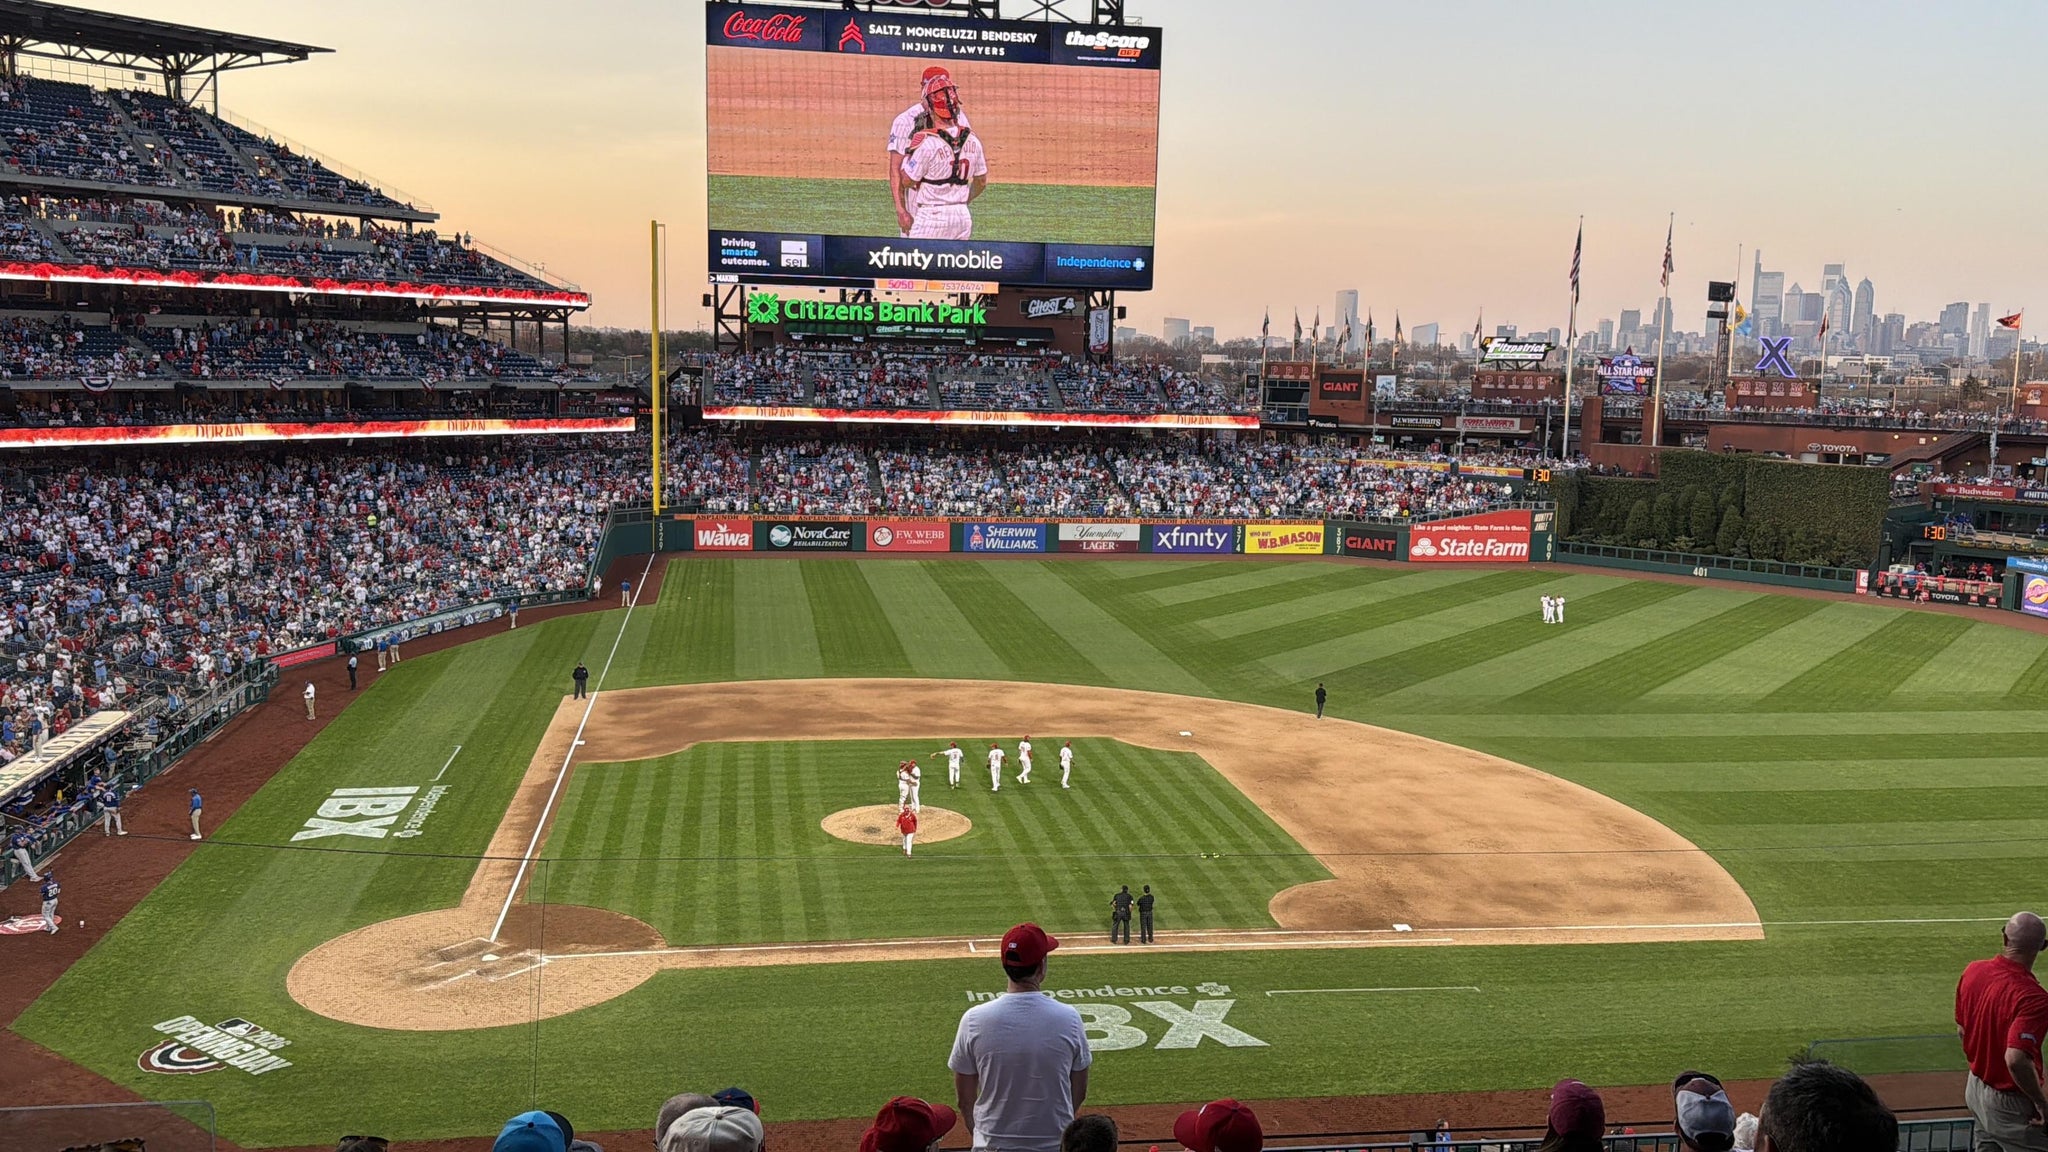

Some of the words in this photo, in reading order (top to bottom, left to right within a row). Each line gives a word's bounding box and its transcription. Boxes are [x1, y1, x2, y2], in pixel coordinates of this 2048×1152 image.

[869, 24, 901, 36] SALTZ
[906, 26, 977, 40] MONGELUZZI
[981, 31, 1037, 43] BENDESKY
[1065, 31, 1149, 49] theScore
[902, 42, 944, 53] INJURY
[953, 44, 1006, 56] LAWYERS
[721, 238, 756, 249] Driving
[721, 248, 758, 257] smarter
[868, 246, 934, 270] xfinity
[937, 250, 1003, 270] mobile
[721, 257, 770, 266] outcomes.
[1057, 256, 1132, 269] Independence
[784, 299, 874, 321] Citizens
[878, 301, 934, 323] Bank
[938, 303, 987, 324] Park
[1597, 365, 1612, 376] ALL
[1612, 365, 1633, 376] STAR
[1632, 365, 1656, 377] GAME
[1323, 382, 1358, 392] GIANT
[1822, 444, 1857, 453] TOYOTA
[1958, 486, 2003, 497] Budweiser
[697, 530, 750, 546] Wawa
[793, 526, 850, 539] NovaCare
[915, 531, 945, 539] WEBB
[1157, 526, 1228, 549] xfinity
[1923, 525, 1946, 541] 1:30
[1083, 541, 1115, 550] LAGER
[1346, 536, 1396, 552] GIANT
[1692, 567, 1708, 577] 401
[1932, 593, 1960, 601] TOYOTA
[290, 786, 420, 842] IBX
[48, 887, 58, 897] 20
[153, 1015, 255, 1060] OPENING
[225, 1048, 293, 1076] DAY
